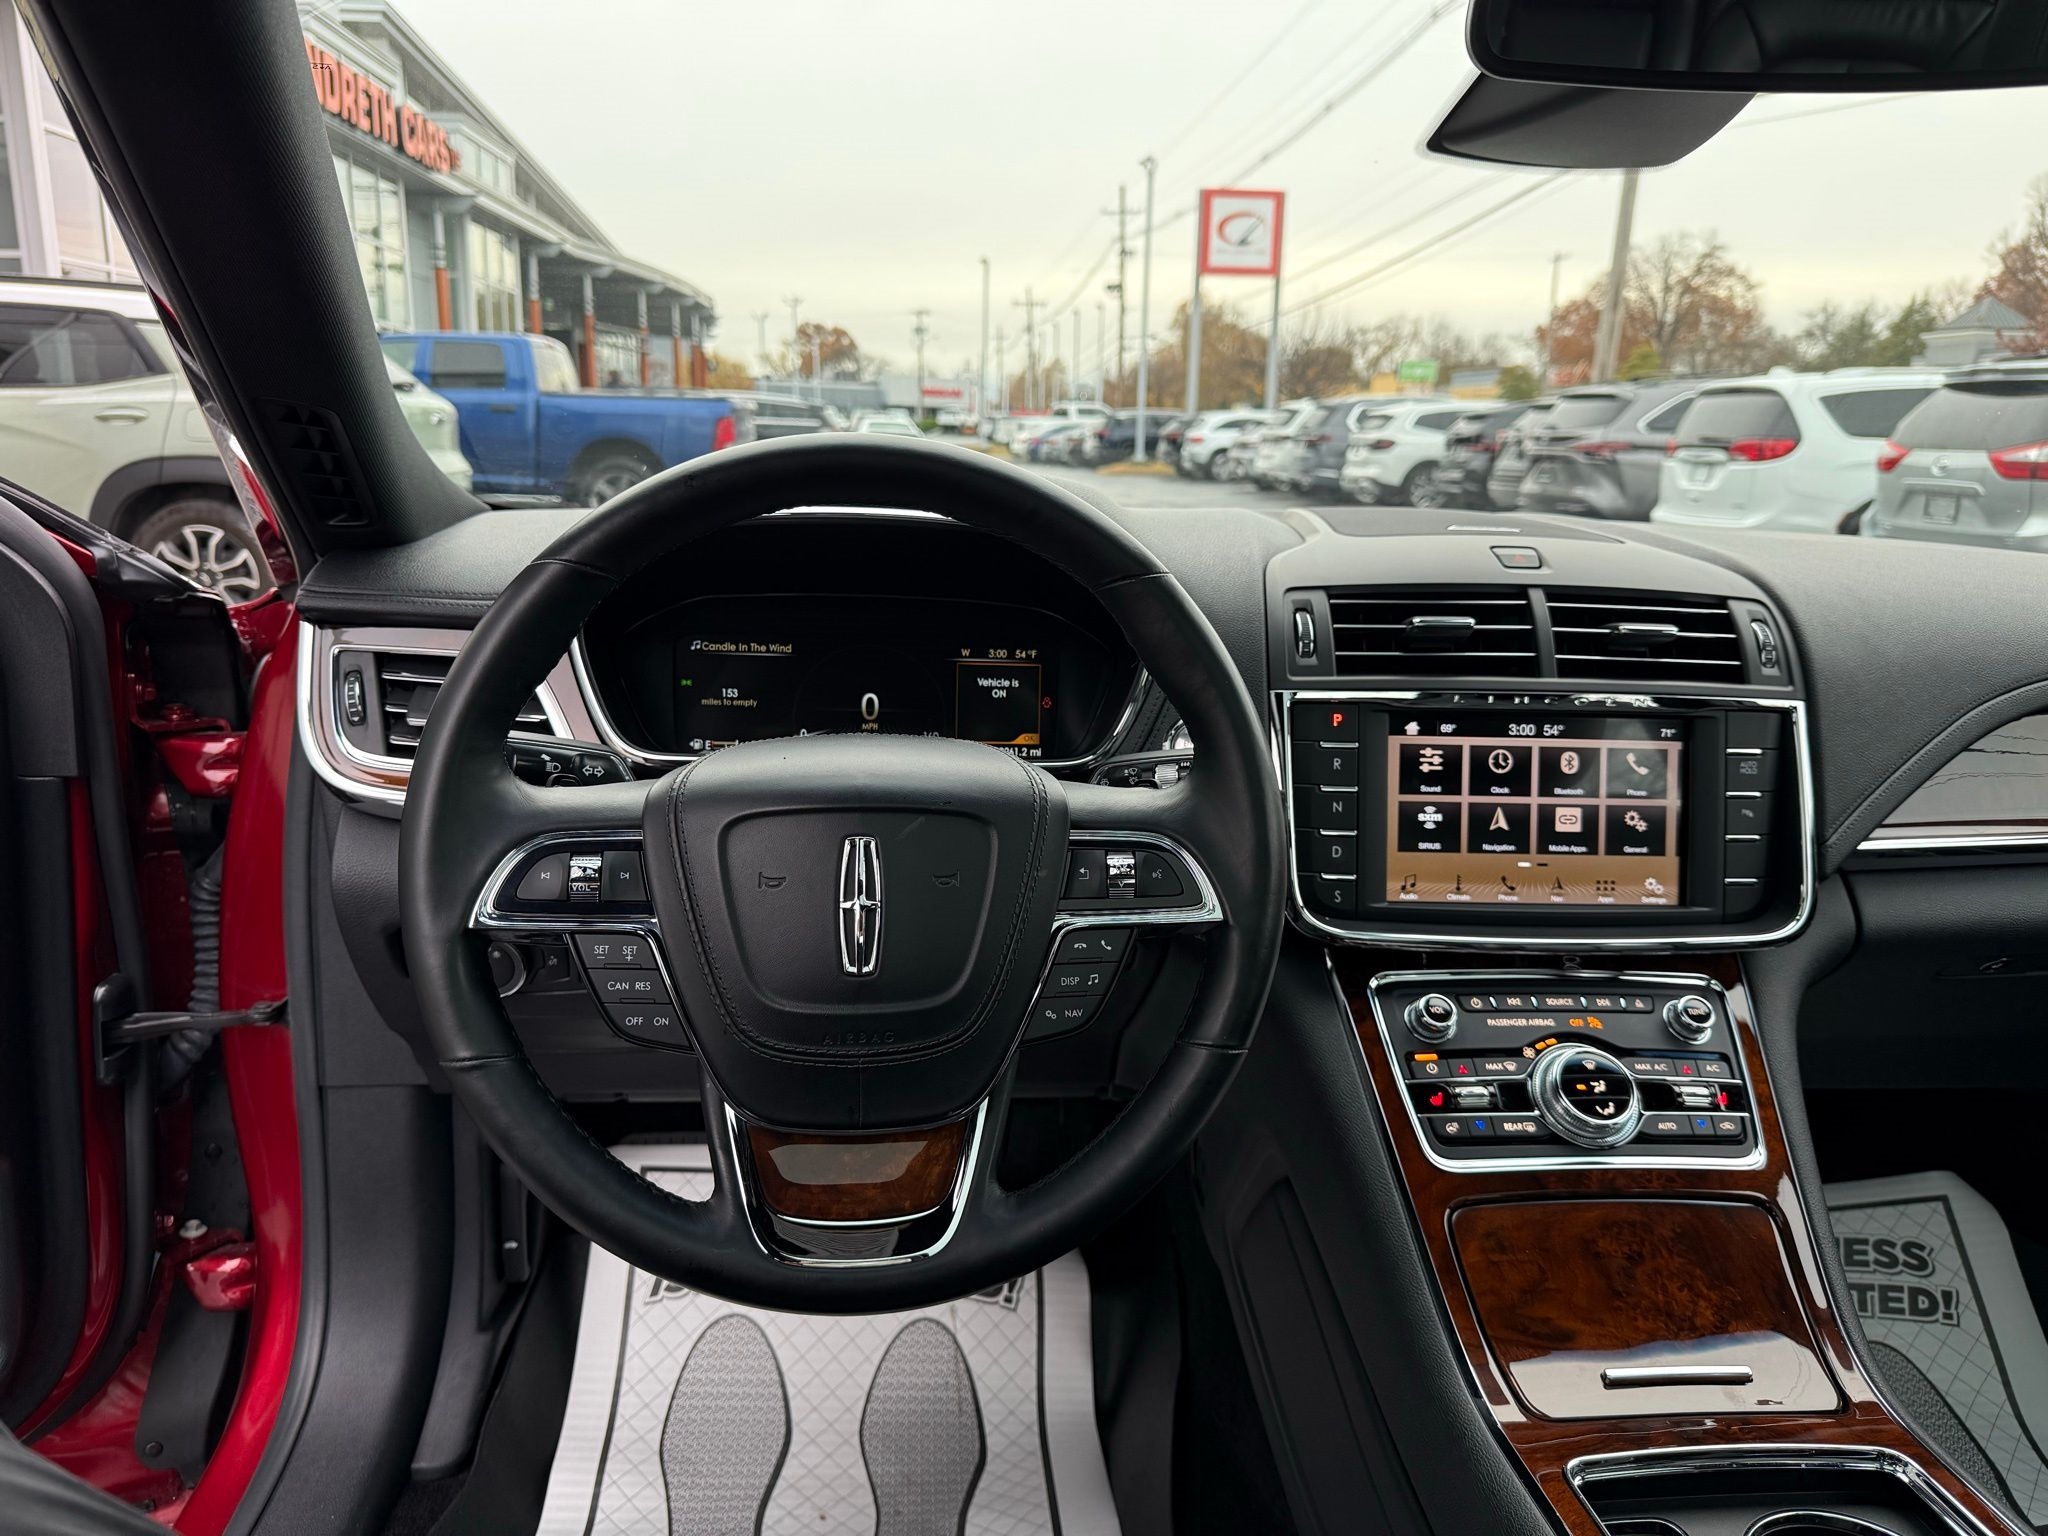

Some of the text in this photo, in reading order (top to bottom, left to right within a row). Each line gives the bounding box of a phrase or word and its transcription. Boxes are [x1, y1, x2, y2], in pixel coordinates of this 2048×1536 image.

[401, 103, 451, 175] CARS
[702, 641, 792, 653] Candle In The Wind
[961, 648, 970, 656] W
[988, 649, 1007, 658] 3:00
[977, 678, 1019, 688] Vehicle is
[722, 688, 739, 698] 153
[992, 690, 1007, 698] ON
[733, 699, 757, 707] empty
[861, 693, 879, 720] 0
[1333, 713, 1343, 727] P
[862, 722, 878, 731] MPH
[1508, 724, 1536, 736] 3:00
[1543, 725, 1566, 736] 54°
[1333, 758, 1341, 770] R
[1420, 785, 1442, 793] Sound
[1332, 801, 1342, 812] N
[1332, 846, 1341, 857] D
[1482, 843, 1516, 851] Navigation
[1549, 844, 1587, 853] Mobile Apps
[1334, 891, 1341, 902] S
[594, 945, 637, 954] SET SET
[607, 981, 651, 990] CAN RES
[1061, 977, 1080, 985] DISP
[1545, 998, 1574, 1006] SOURCE
[1065, 1009, 1083, 1018] NAV
[1429, 1006, 1445, 1014] VOL
[625, 1016, 669, 1026] OFF ON
[1487, 1018, 1528, 1026] PASSENGER
[1528, 1018, 1556, 1026] AIRBAG
[823, 1032, 895, 1045] AIRBAG
[1486, 1062, 1503, 1071] MAX
[1654, 1063, 1669, 1071] A/C
[1503, 1122, 1523, 1131] REAR
[1658, 1122, 1677, 1130] AUTO
[1836, 1237, 1933, 1276] ESS
